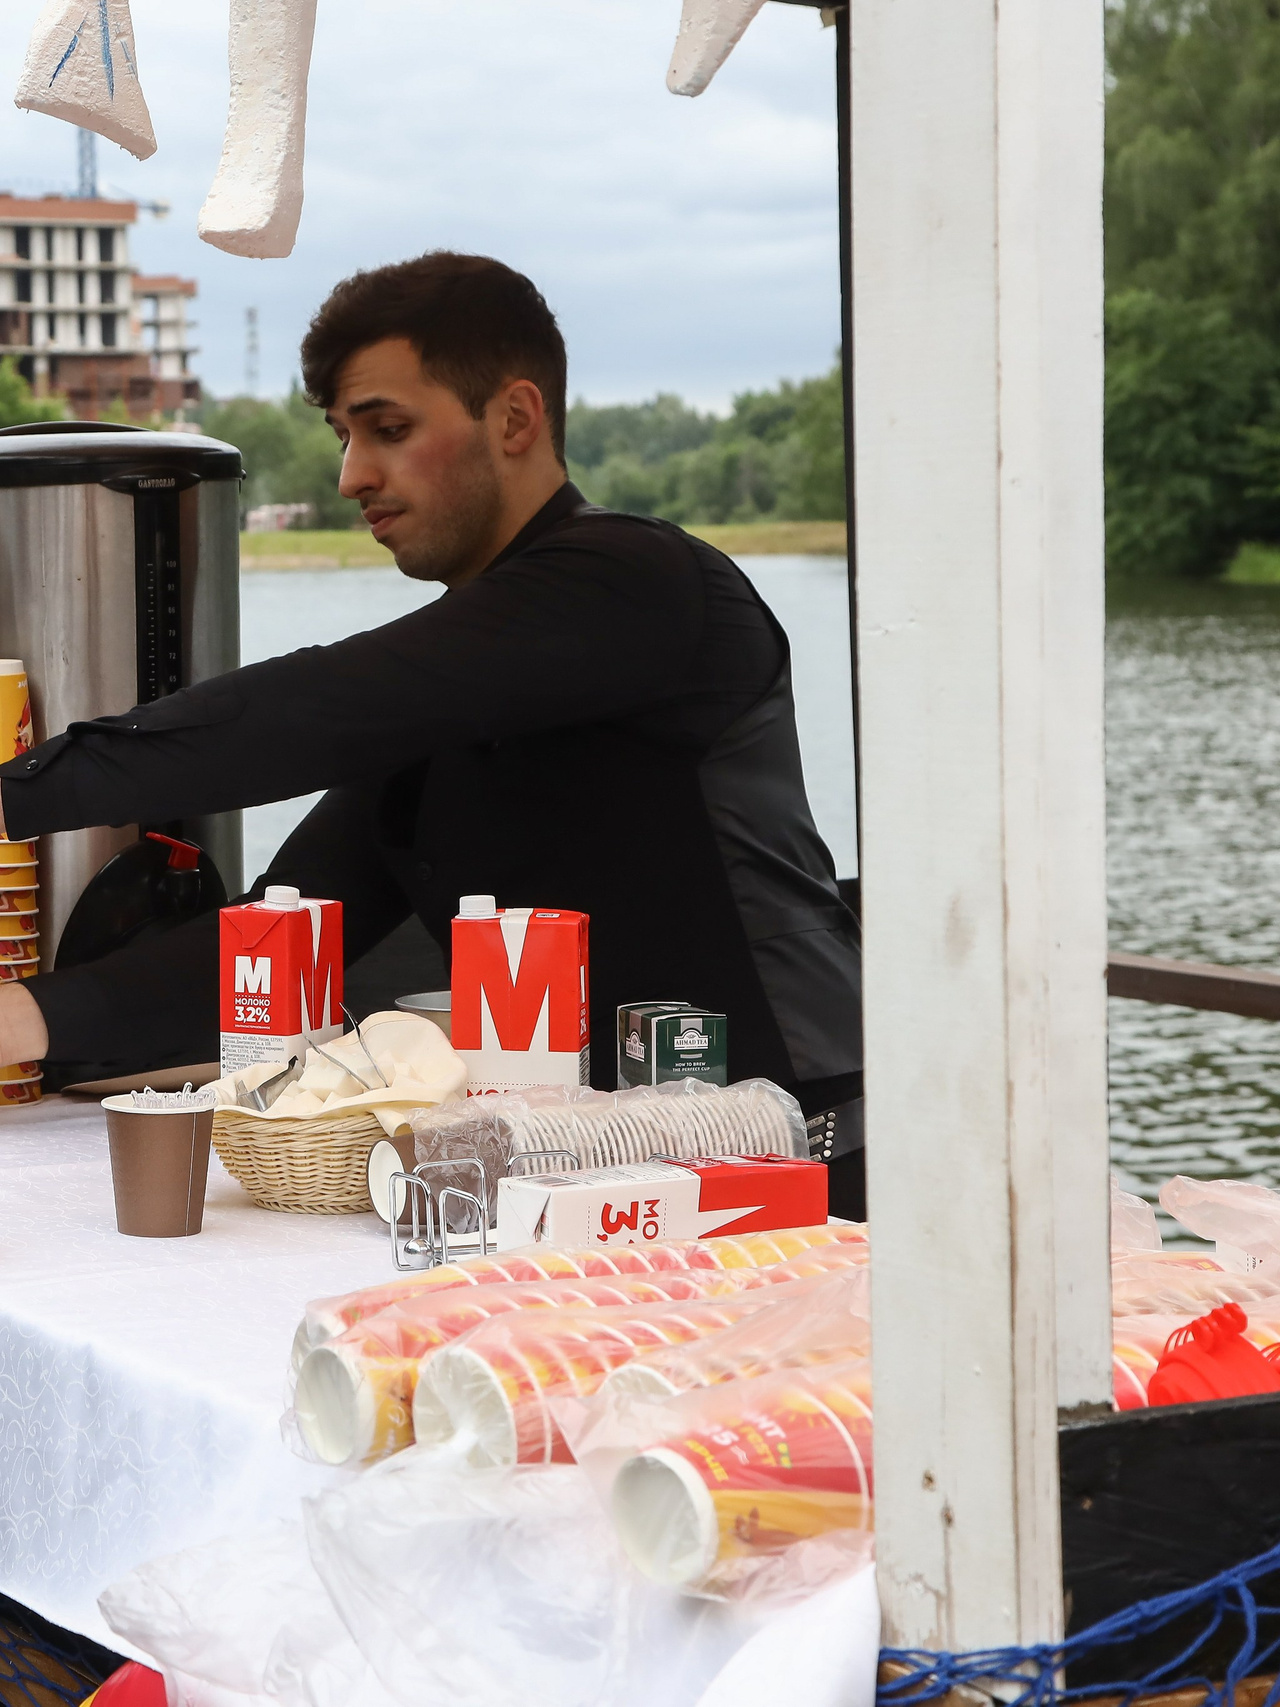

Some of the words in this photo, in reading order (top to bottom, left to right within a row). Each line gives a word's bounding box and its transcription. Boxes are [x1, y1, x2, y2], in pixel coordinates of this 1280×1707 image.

[234, 955, 272, 995] М
[234, 997, 271, 1007] МОЛОКО
[234, 1005, 271, 1024] 3,2%
[596, 1200, 640, 1246] 3,
